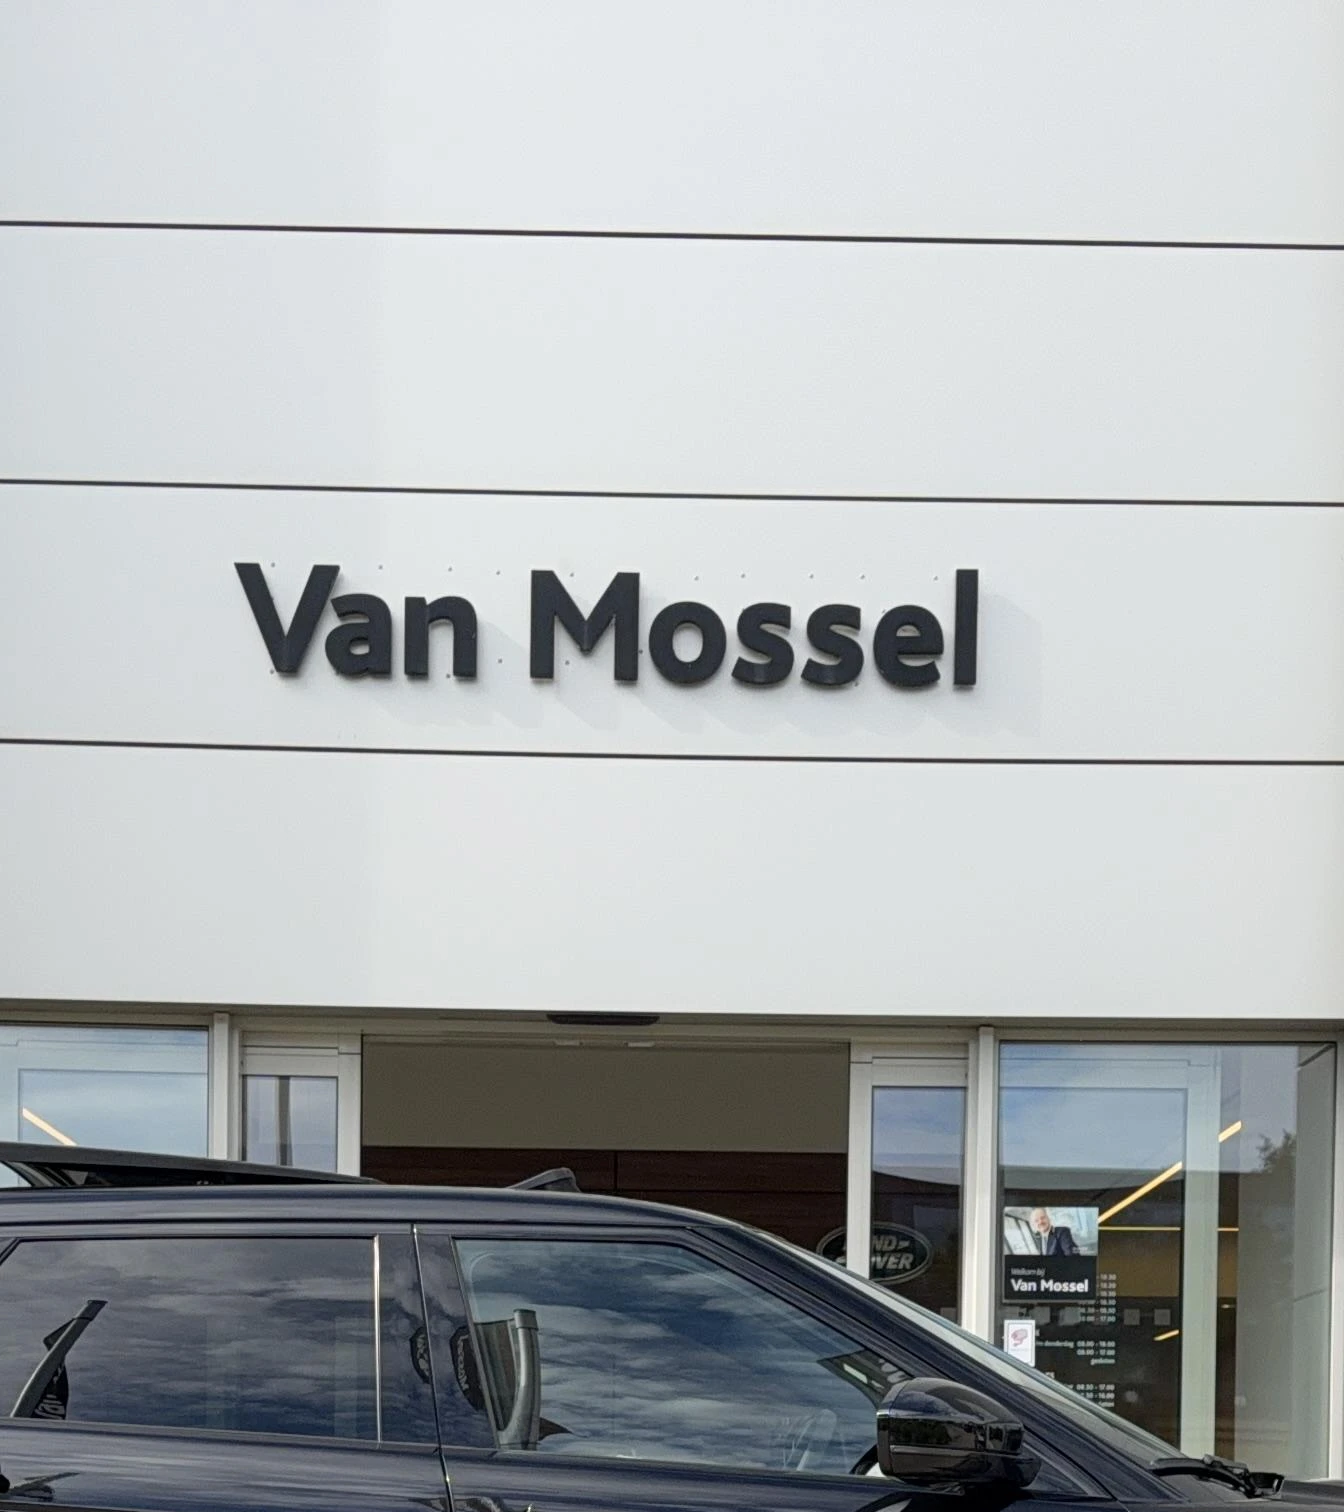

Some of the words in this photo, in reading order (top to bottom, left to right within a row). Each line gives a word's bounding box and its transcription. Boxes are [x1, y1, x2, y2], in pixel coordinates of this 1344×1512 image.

[235, 562, 478, 682] Van
[530, 569, 979, 692] Mossel
[1009, 1278, 1037, 1292] Van
[1040, 1279, 1089, 1293] Mossel
